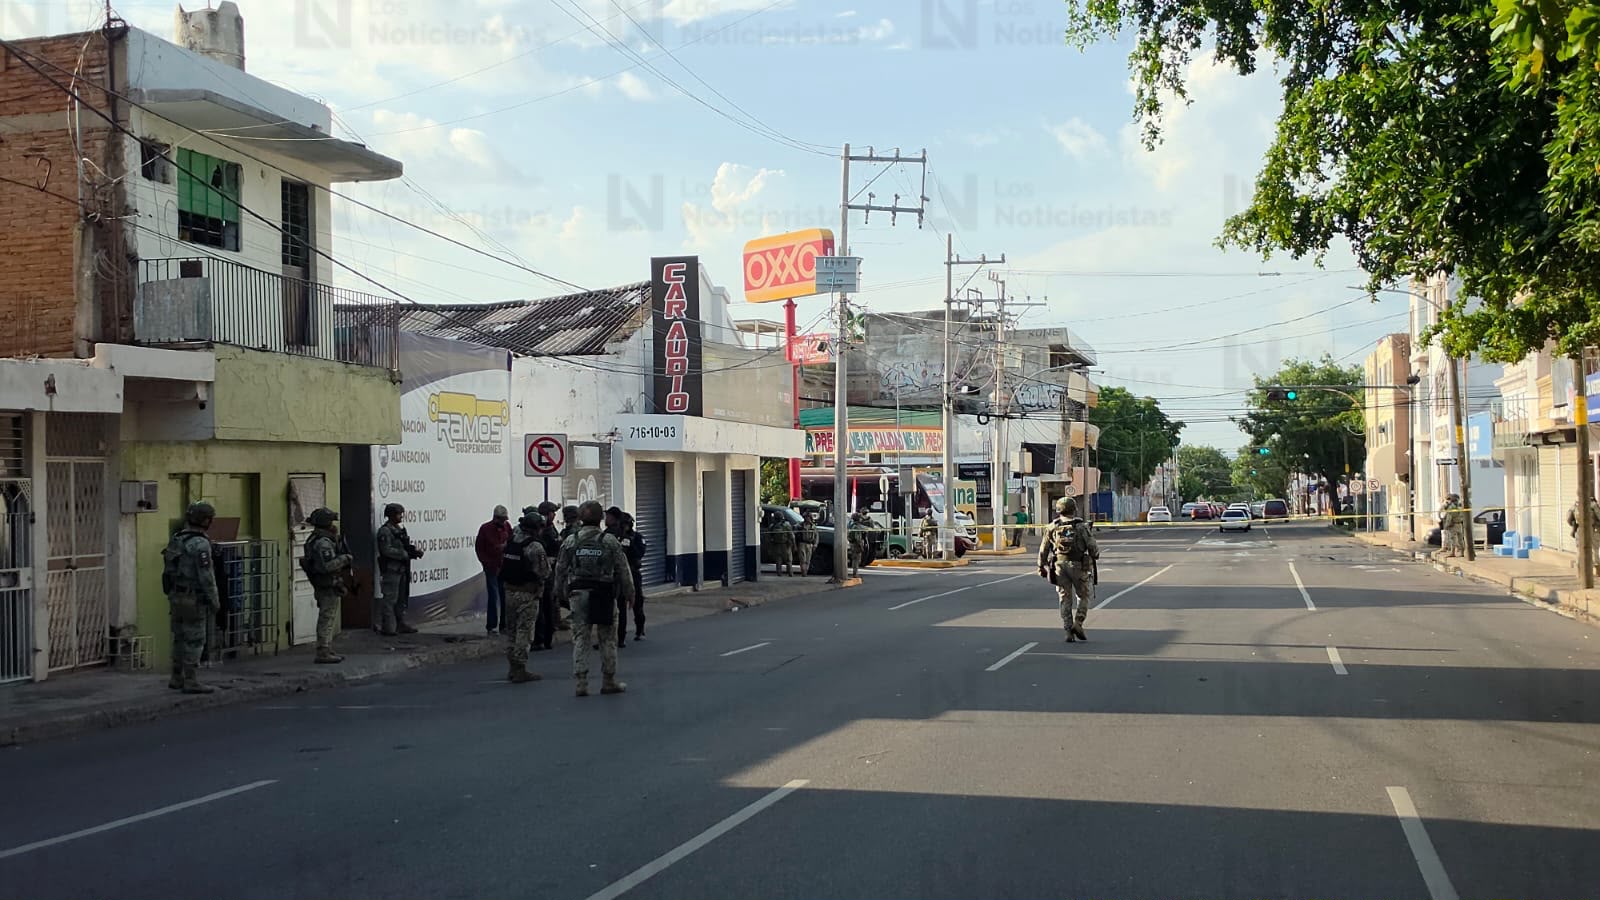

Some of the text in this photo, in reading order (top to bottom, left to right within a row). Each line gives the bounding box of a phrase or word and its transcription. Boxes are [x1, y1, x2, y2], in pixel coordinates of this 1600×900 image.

[745, 244, 816, 288] OXXO
[663, 262, 690, 413] CAR AUDIO
[400, 417, 426, 432] NACIÓN
[456, 443, 502, 454] SUSPENSIONES
[391, 480, 425, 493] BALANCEO
[418, 510, 423, 523] Y
[424, 509, 446, 522] CLUTCH
[429, 539, 437, 551] DE
[438, 537, 460, 550] DISCOS
[460, 536, 465, 548] Y
[419, 570, 428, 583] DE
[429, 568, 449, 581] ACEITE
